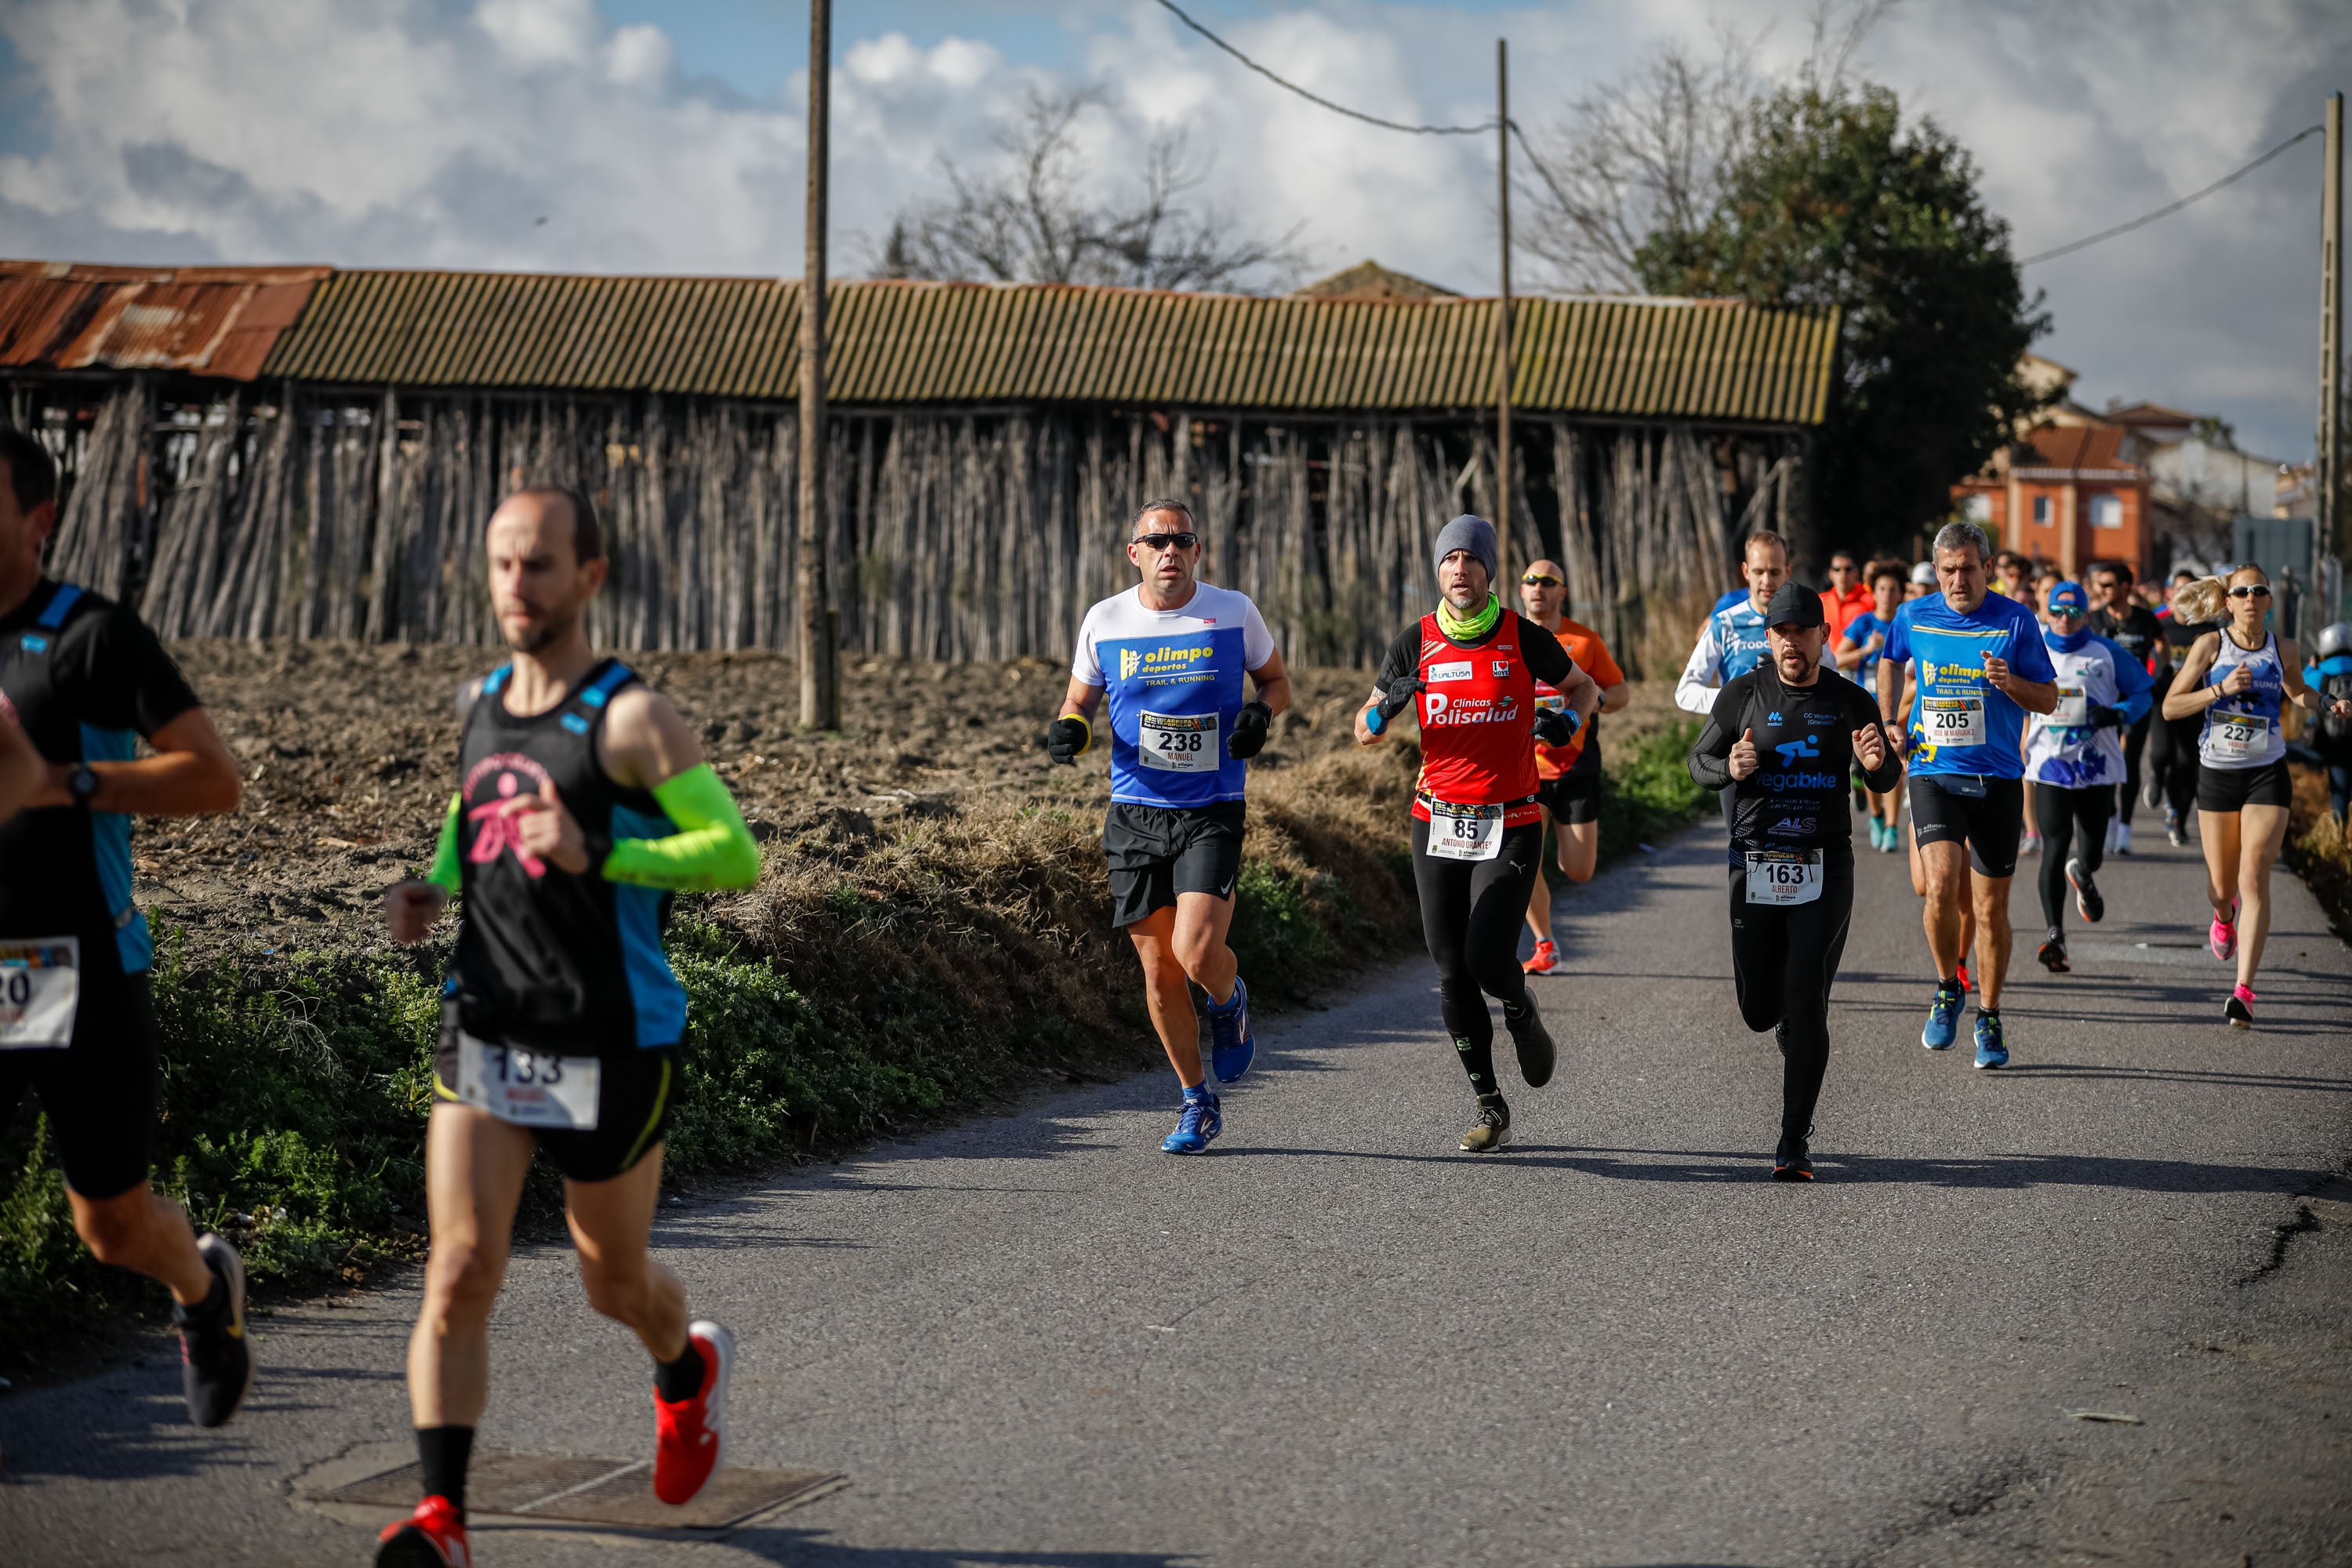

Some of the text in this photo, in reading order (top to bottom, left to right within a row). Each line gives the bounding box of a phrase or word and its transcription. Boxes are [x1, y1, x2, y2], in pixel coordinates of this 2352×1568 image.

[1145, 647, 1214, 662] olimpo
[1142, 663, 1187, 673] deportes
[1494, 662, 1497, 670] I
[1178, 674, 1215, 684] RUNNING
[1425, 693, 1519, 725] Polisalud
[1453, 698, 1491, 708] Clínicas
[1936, 713, 1969, 728] 205
[2223, 725, 2255, 742] 227
[1159, 732, 1202, 751] 238
[1167, 752, 1194, 760] MANUEL
[1454, 819, 1478, 840] 85
[1441, 837, 1493, 850] ANTONIO ORANTES
[1766, 865, 1804, 884] 163
[1771, 885, 1798, 894] ALBERTO
[0, 971, 30, 1004] 0
